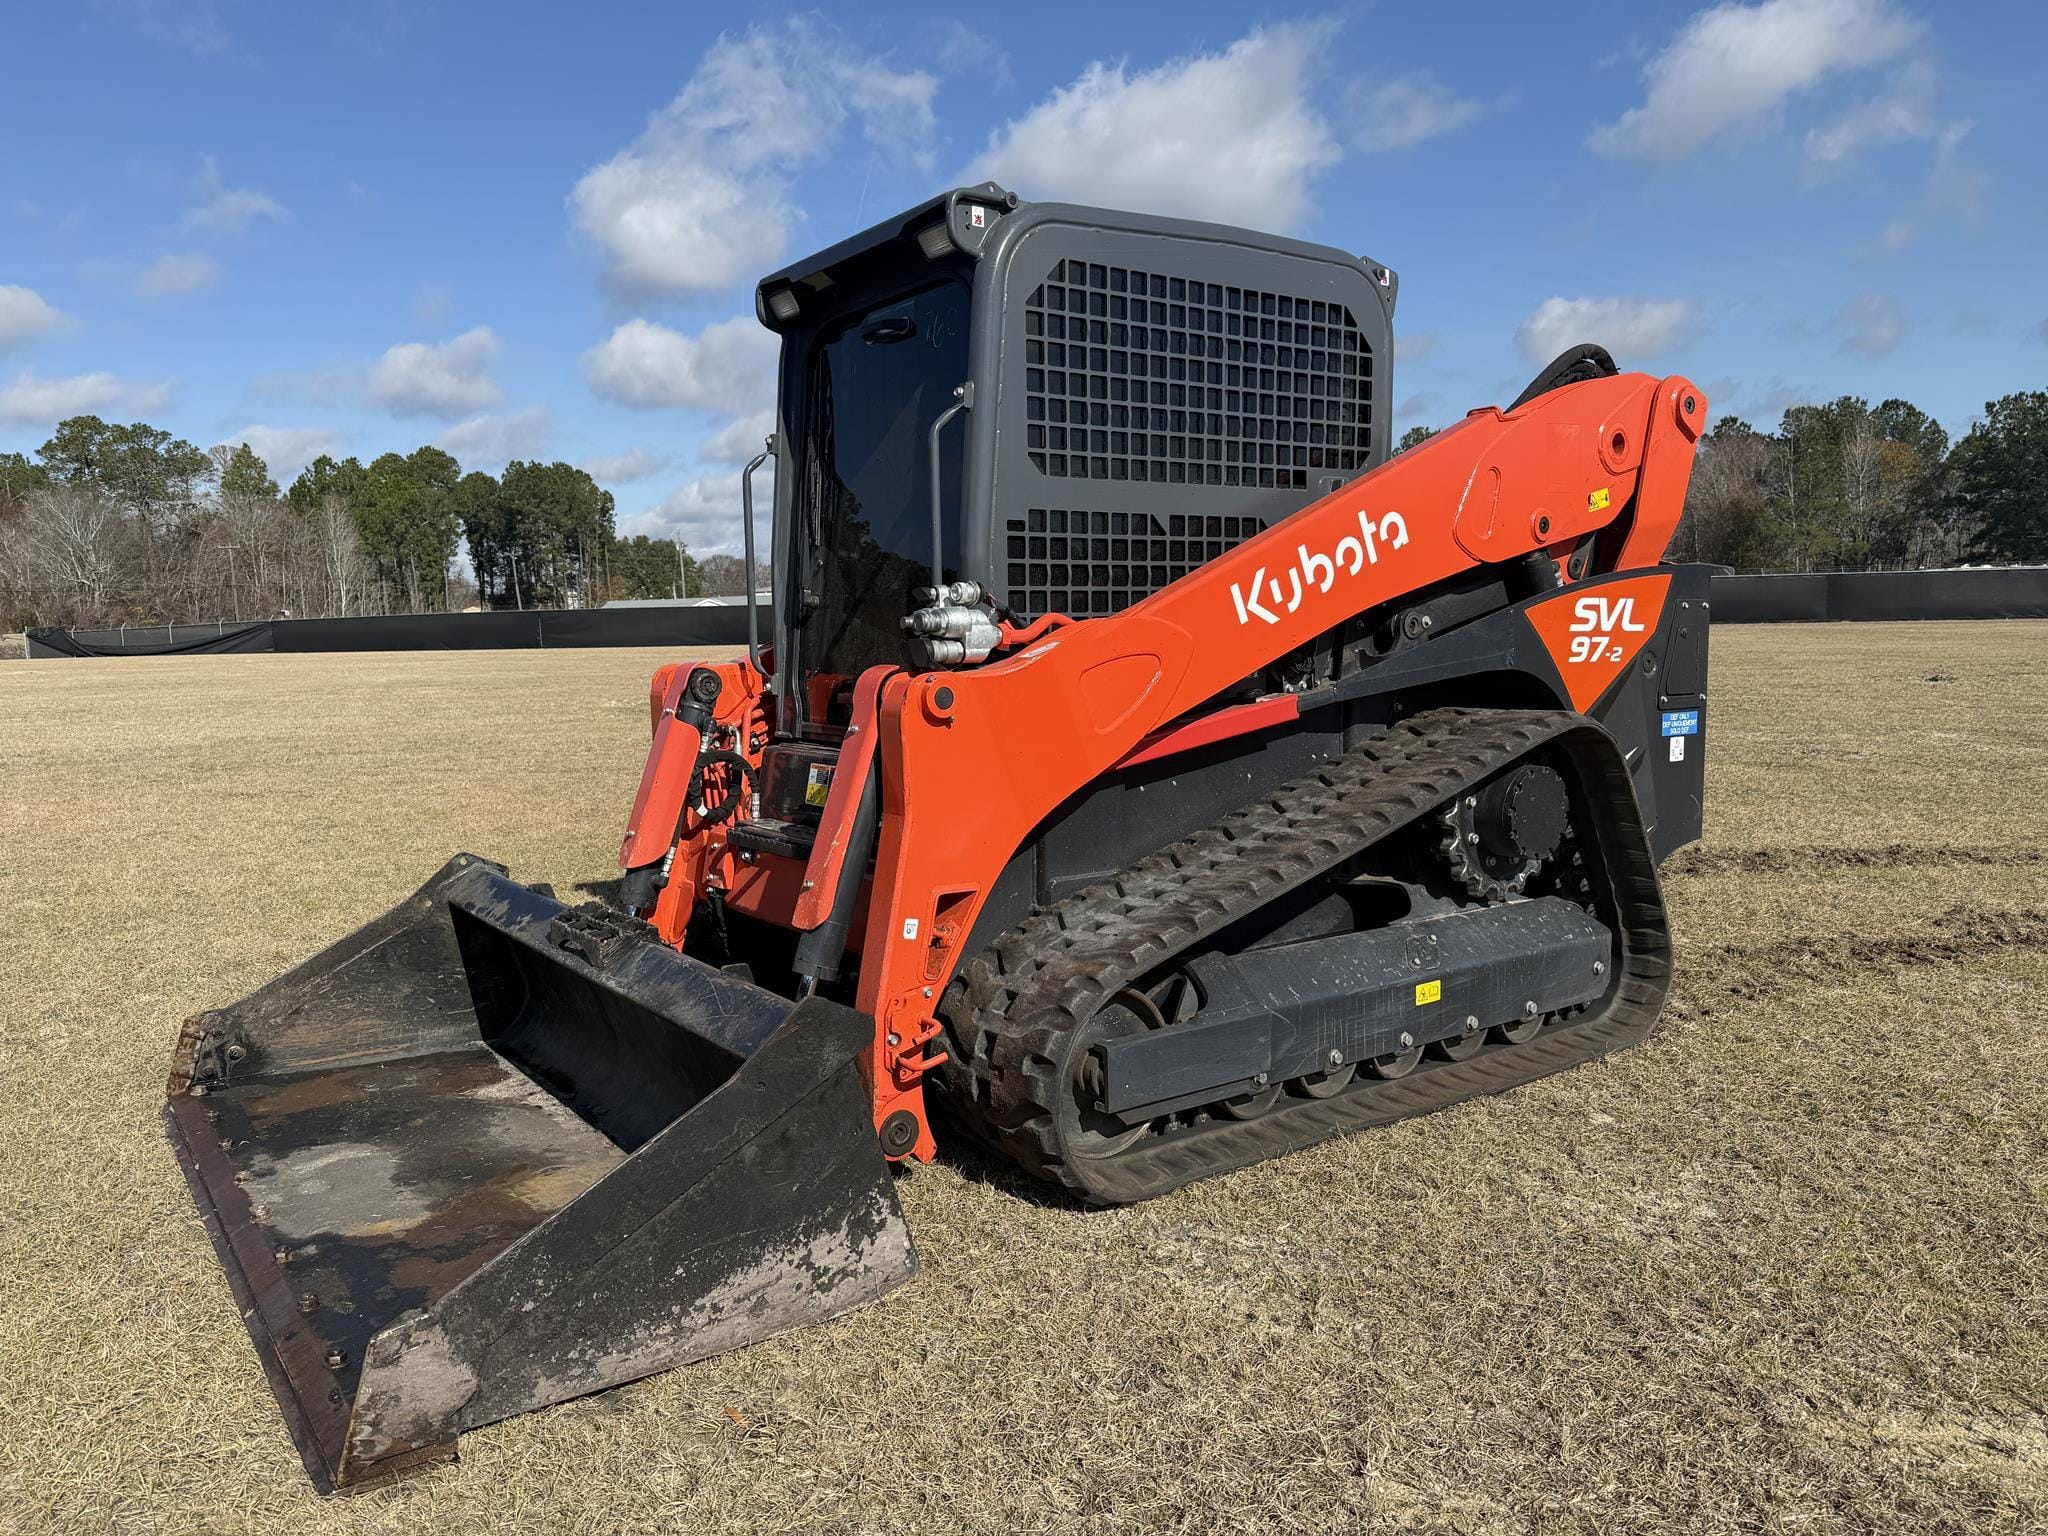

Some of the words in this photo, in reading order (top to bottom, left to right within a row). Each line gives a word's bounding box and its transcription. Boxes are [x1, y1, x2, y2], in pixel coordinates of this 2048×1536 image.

[1229, 509, 1409, 625] Kubota
[1569, 597, 1645, 632] SVL
[1568, 636, 1623, 663] 97-2
